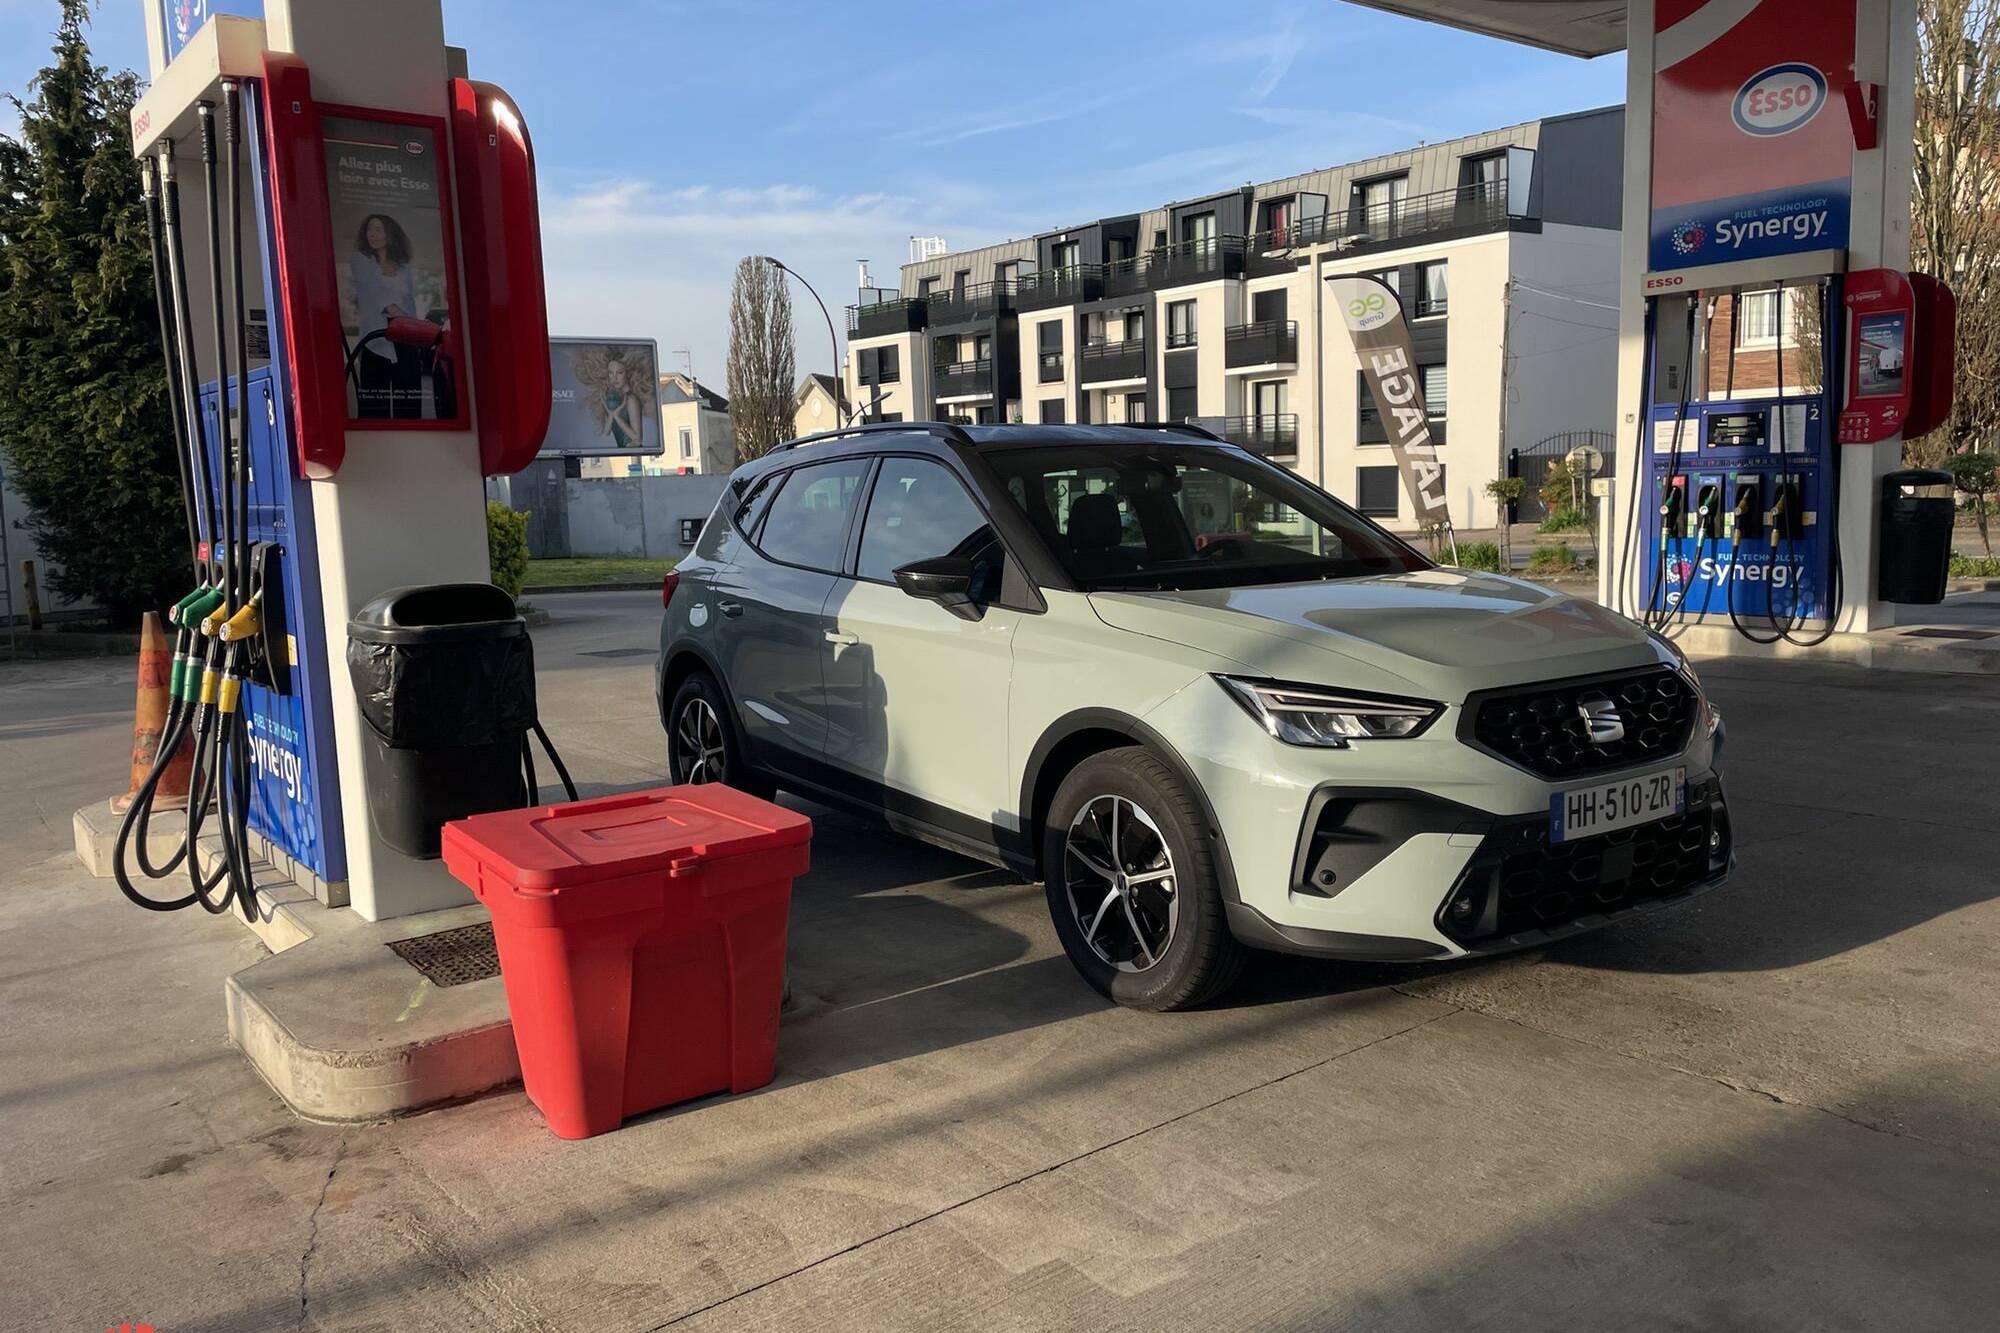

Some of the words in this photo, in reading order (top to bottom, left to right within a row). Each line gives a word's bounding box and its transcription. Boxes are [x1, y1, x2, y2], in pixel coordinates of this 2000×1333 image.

[1748, 84, 1812, 117] Esso
[133, 110, 150, 140] ESSO
[339, 156, 372, 171] Allez
[375, 160, 402, 174] plus
[339, 170, 364, 184] loin
[367, 175, 398, 188] avec
[400, 177, 430, 191] Esso
[1734, 207, 1758, 220] FUEL
[1761, 197, 1828, 216] TECHNOLOGY
[1715, 210, 1828, 249] Synergy
[1646, 276, 1684, 289] ESSO
[267, 398, 275, 426] 8
[1809, 408, 1820, 421] 2
[1699, 557, 1805, 588] Synergy
[246, 719, 302, 803] Synergy
[1567, 775, 1671, 830] HH-510-ZR
